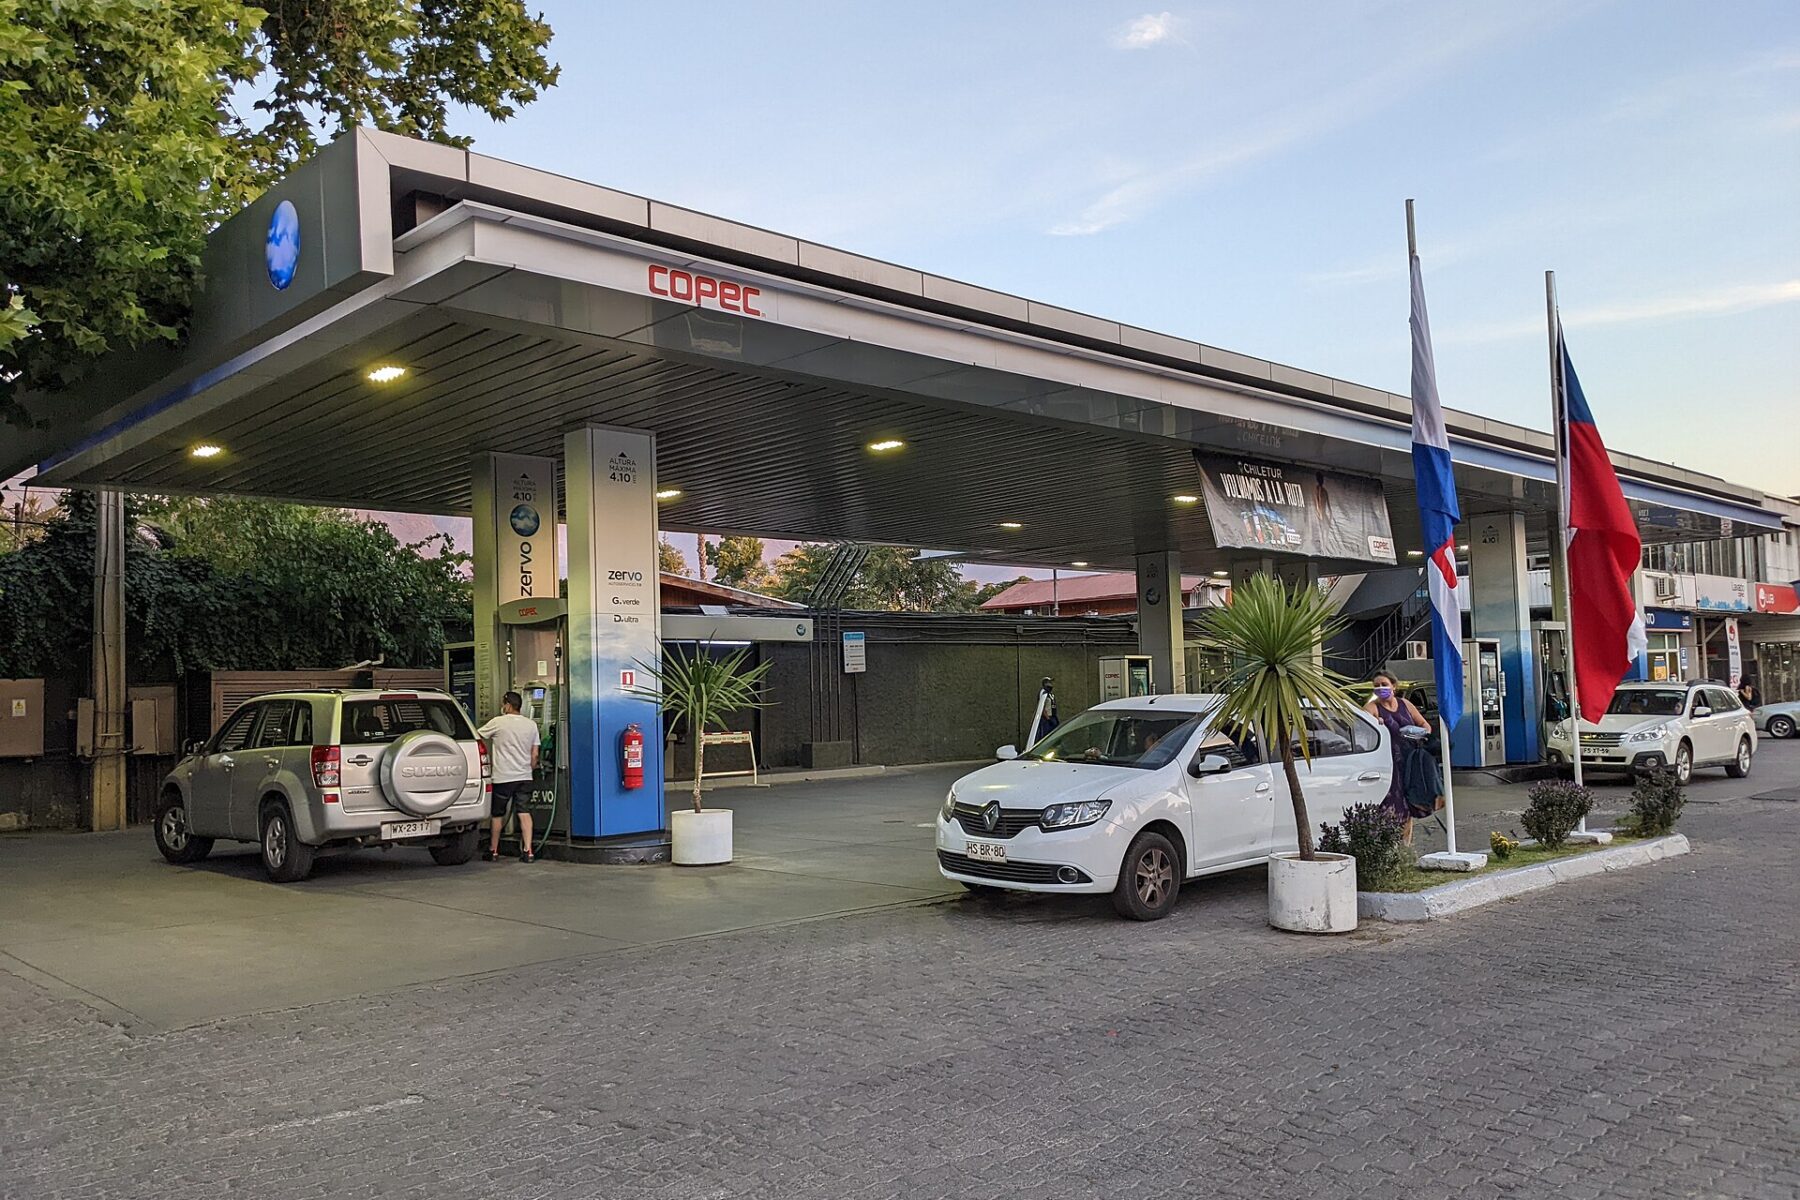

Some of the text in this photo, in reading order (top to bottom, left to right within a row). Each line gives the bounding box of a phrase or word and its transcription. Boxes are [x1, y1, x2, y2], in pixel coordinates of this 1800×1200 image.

[609, 458, 636, 466] ALTURA
[609, 471, 631, 483] 4.10
[1243, 463, 1283, 479] CHILETUR
[512, 492, 532, 501] 4.10
[1220, 473, 1305, 508] VOLVAMOS A LA RUTA
[520, 541, 532, 597] zervo
[608, 570, 643, 581] zervo
[401, 765, 463, 779] SUZUKI
